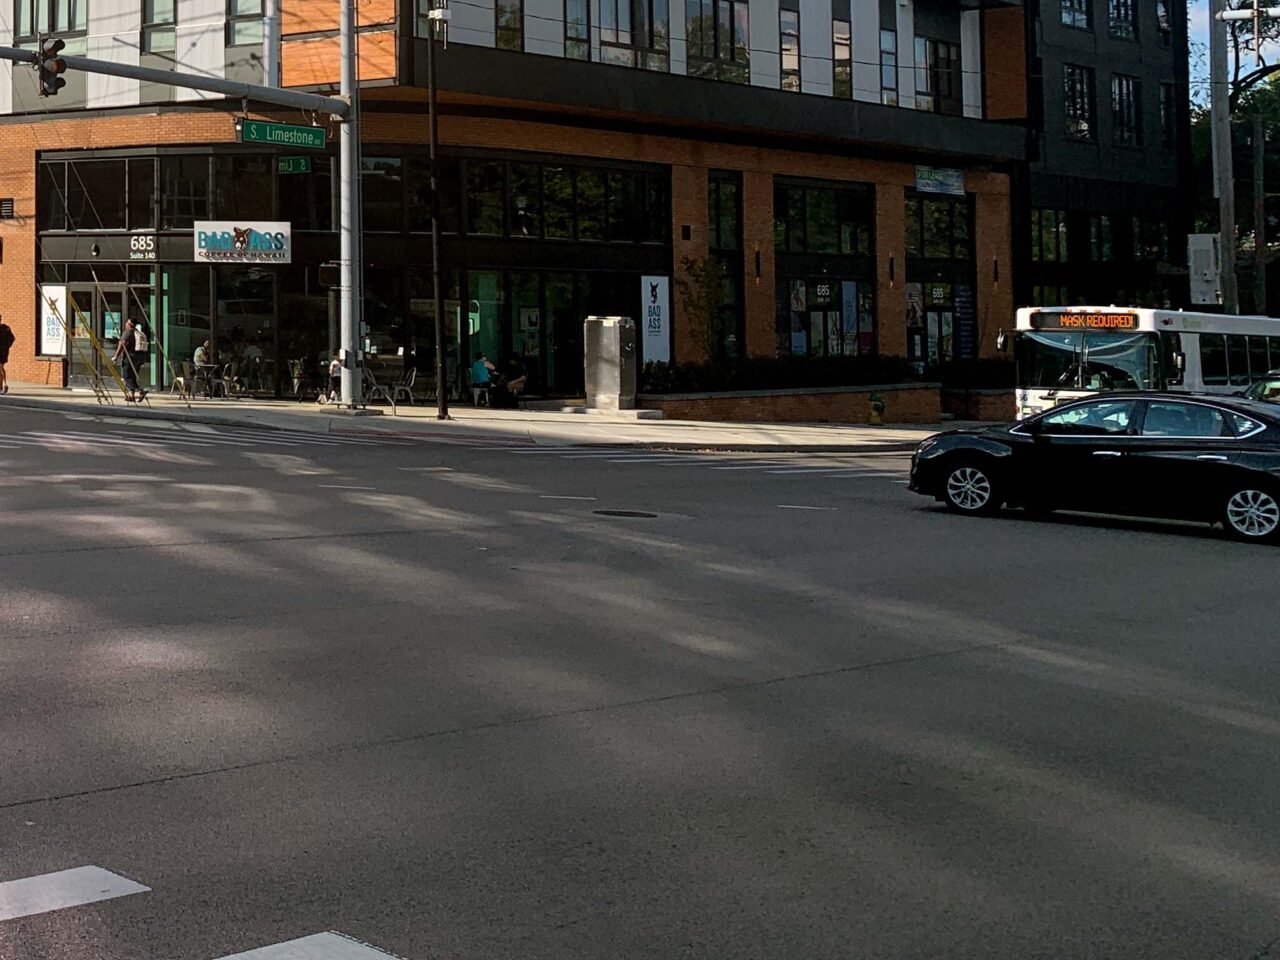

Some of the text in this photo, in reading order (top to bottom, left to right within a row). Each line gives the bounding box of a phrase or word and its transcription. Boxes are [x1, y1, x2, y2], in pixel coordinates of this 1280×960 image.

[250, 124, 314, 145] S. Limestone
[130, 236, 154, 250] 685
[198, 230, 285, 250] BAD ASS
[817, 285, 830, 296] 685
[932, 288, 944, 298] 685
[648, 305, 661, 317] BAD
[46, 316, 60, 327] BAD
[648, 317, 661, 330] ASS
[1060, 315, 1134, 328] MASK REQUIRED!
[46, 327, 61, 337] ASS
